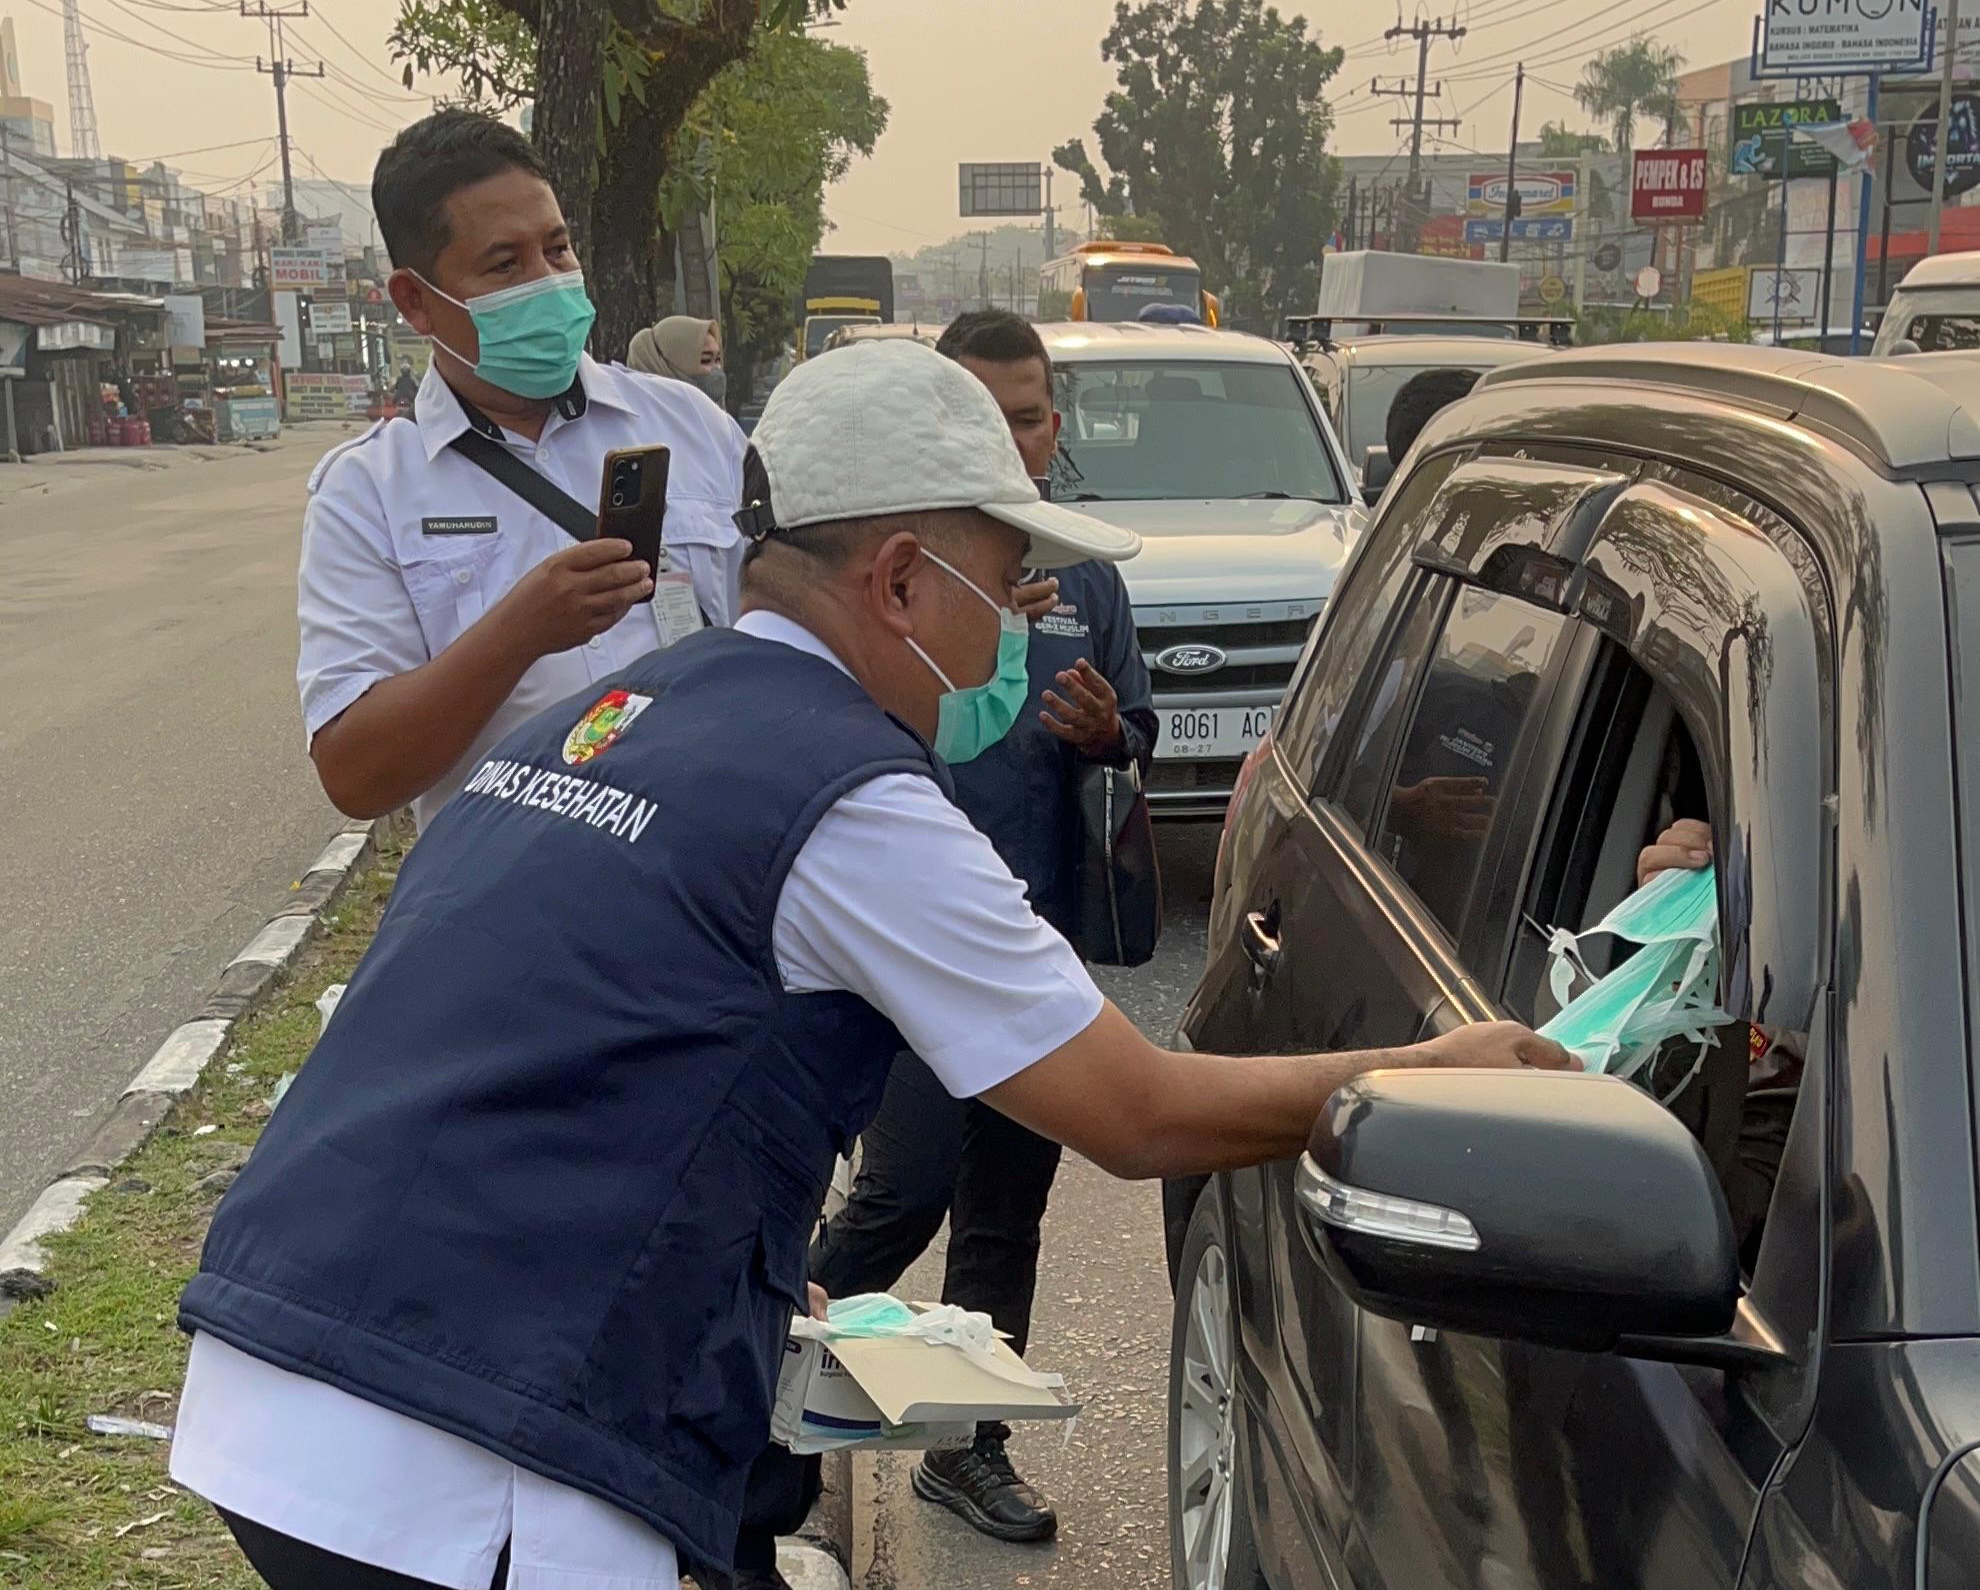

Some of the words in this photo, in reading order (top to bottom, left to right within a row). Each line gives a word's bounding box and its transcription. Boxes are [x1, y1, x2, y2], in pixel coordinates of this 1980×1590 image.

[1808, 24, 1859, 34] MATEMATIKA
[1769, 41, 1800, 51] BAHASA
[1841, 39, 1873, 49] BAHASA
[1874, 37, 1917, 47] INDONESIA
[1741, 106, 1829, 128] LAZORA
[1636, 159, 1679, 190] PEMPEK
[1689, 158, 1704, 190] ES
[275, 269, 324, 280] MOBIL
[1159, 605, 1305, 622] NGER
[1172, 651, 1211, 667] Ford
[1171, 713, 1218, 739] 8061
[1241, 711, 1267, 738] AC
[464, 760, 531, 799] DINAS
[513, 767, 659, 844] KESEHATAN
